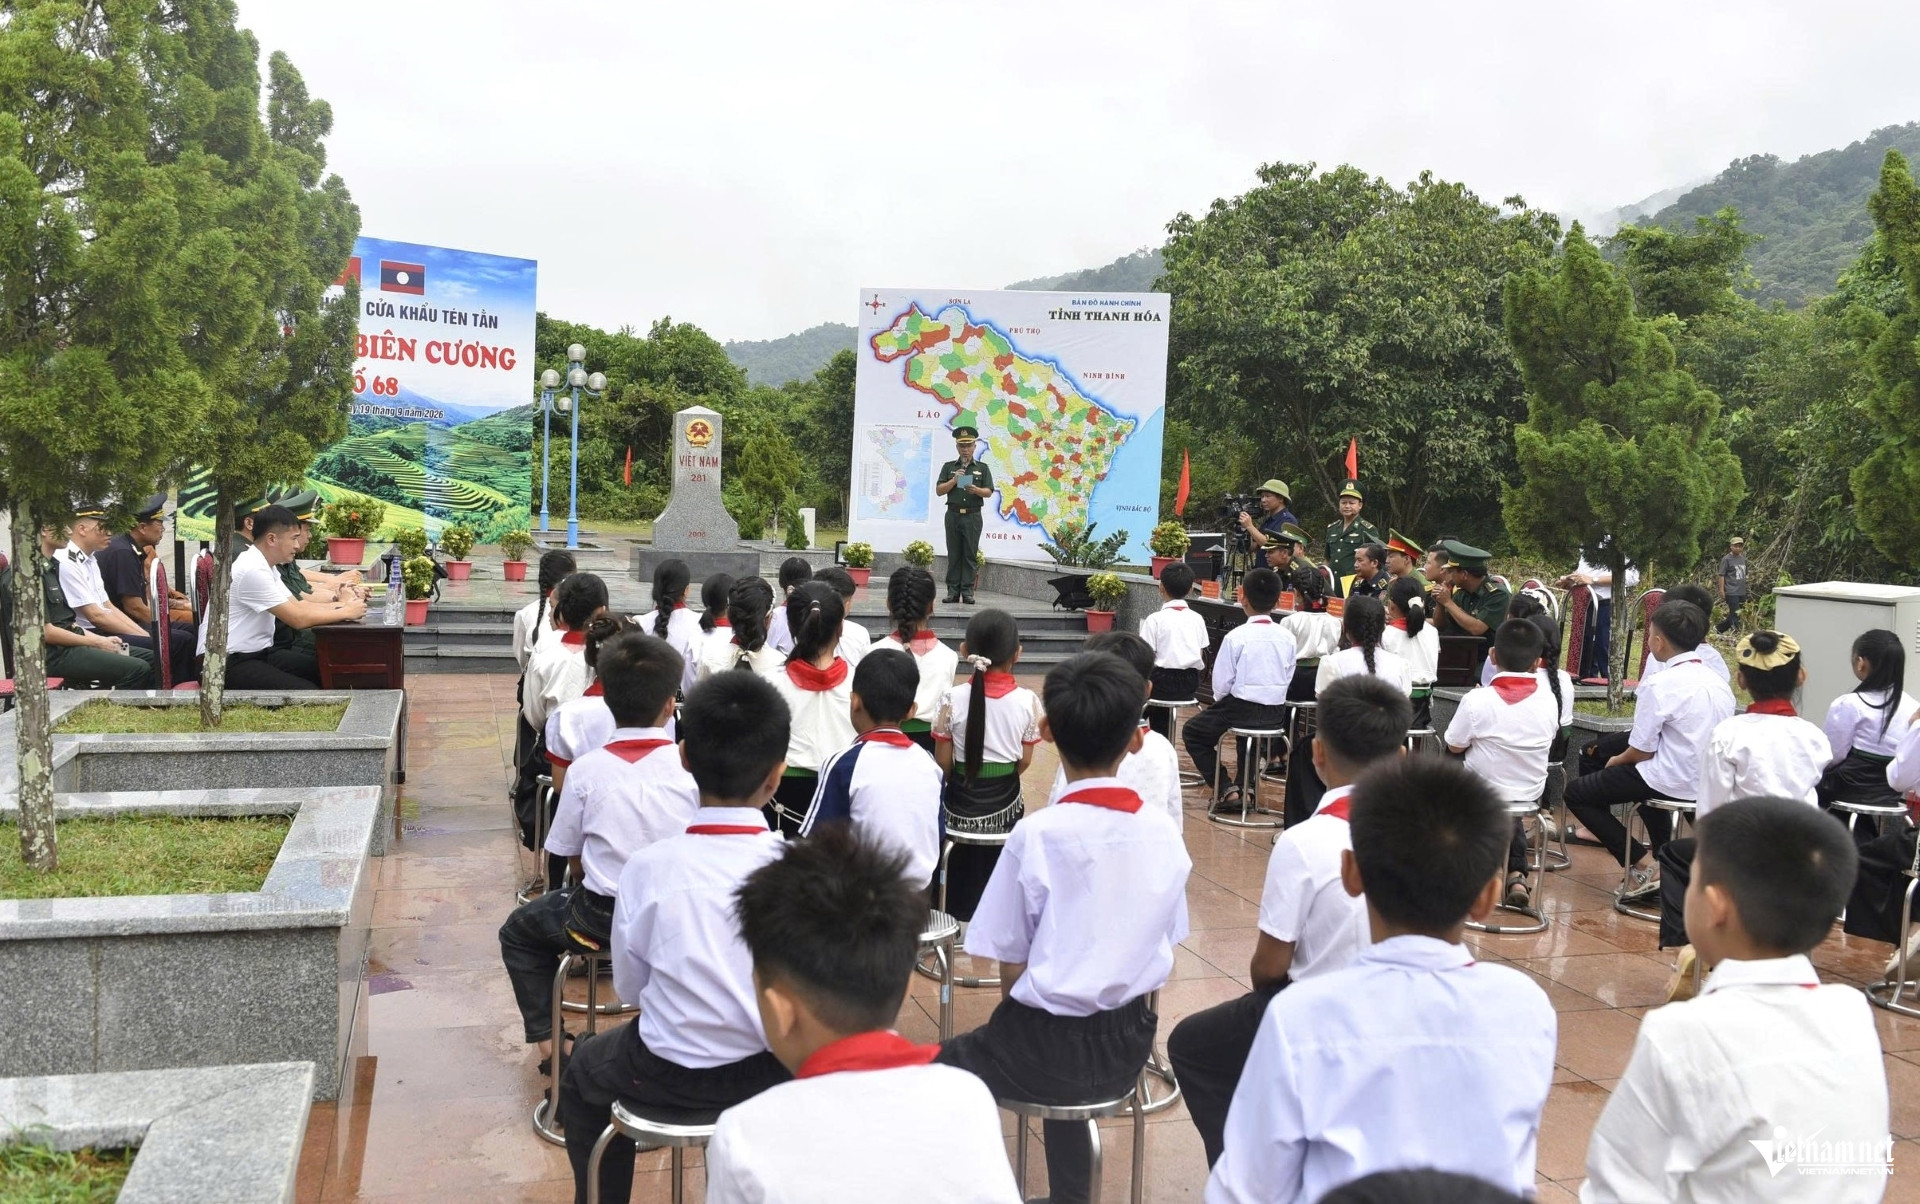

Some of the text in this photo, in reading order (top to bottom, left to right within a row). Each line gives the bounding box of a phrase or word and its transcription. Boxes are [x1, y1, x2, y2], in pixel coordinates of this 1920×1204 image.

[365, 298, 395, 318] CỬA
[399, 302, 438, 323] KHẨU
[1048, 307, 1162, 322] TỈNH THANH HÓA
[354, 328, 517, 371] BIÊN CƯƠNG
[353, 366, 399, 396] Ố 68
[1082, 371, 1103, 379] NINH
[360, 404, 370, 414] 19
[372, 404, 395, 417] tháng
[397, 407, 403, 416] 9
[424, 409, 444, 419] 2026
[917, 410, 941, 419] LÀO
[679, 452, 719, 471] VIỆT NAM
[690, 473, 707, 482] 281
